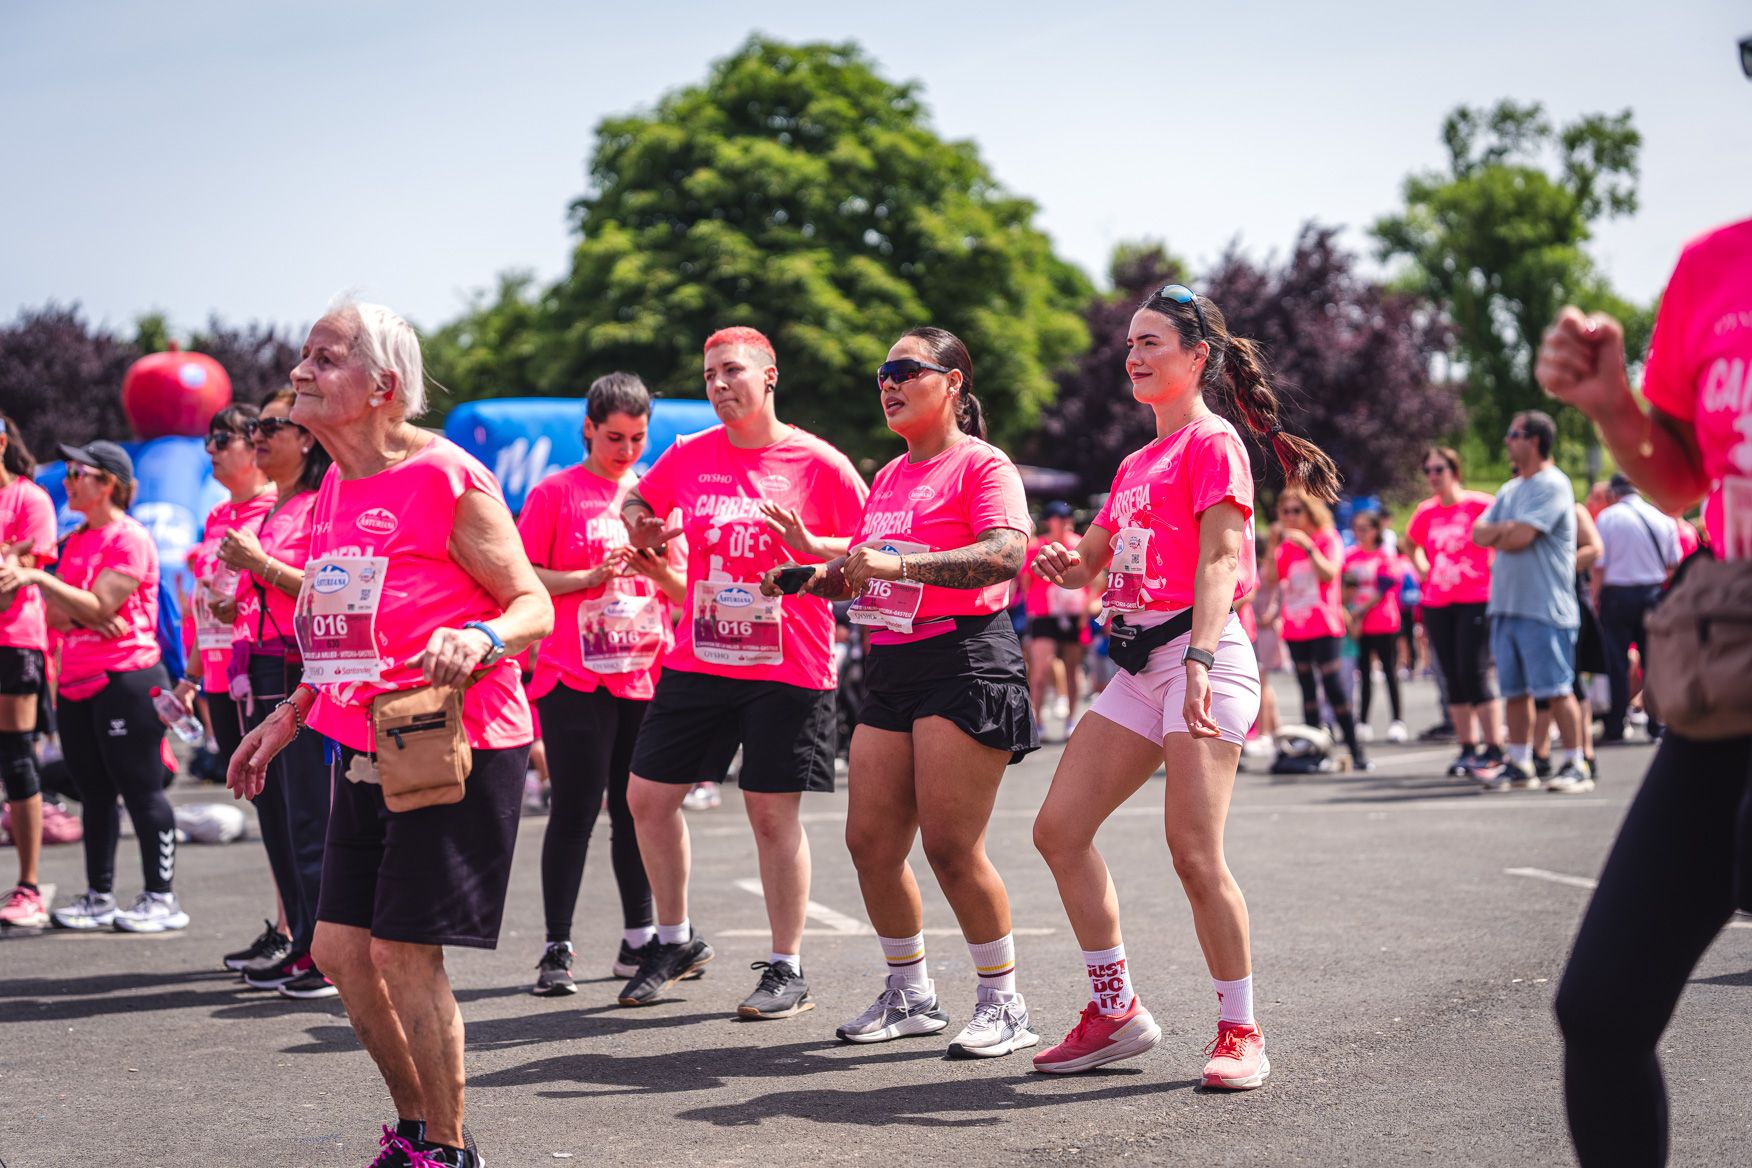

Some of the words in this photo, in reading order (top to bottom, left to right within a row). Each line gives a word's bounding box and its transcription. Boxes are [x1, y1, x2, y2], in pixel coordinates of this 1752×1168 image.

[698, 473, 733, 484] OYSHO
[1110, 483, 1151, 522] ARRERA
[1108, 573, 1124, 588] 16
[313, 614, 348, 636] 016
[718, 621, 752, 636] 016
[607, 630, 640, 644] 016
[1093, 977, 1124, 993] DO
